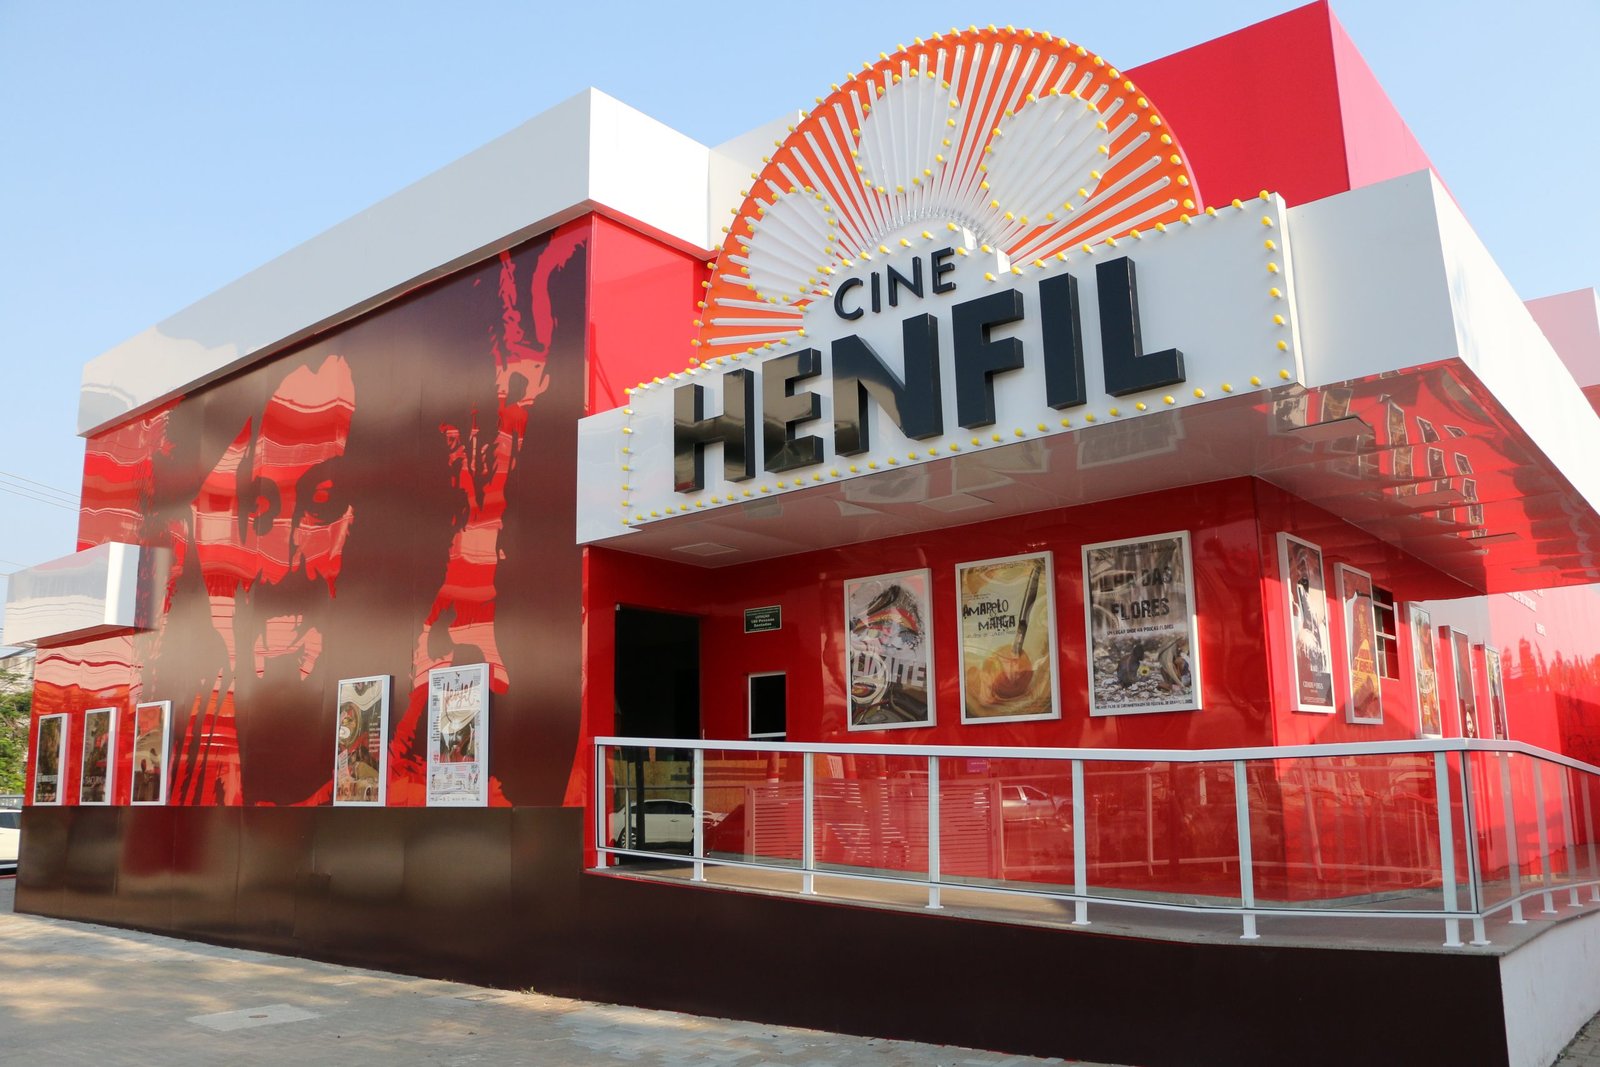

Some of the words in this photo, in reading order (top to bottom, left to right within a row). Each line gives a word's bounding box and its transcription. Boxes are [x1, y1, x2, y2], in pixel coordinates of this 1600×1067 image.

[834, 246, 957, 321] CINE
[673, 256, 1186, 493] HENFIL
[978, 615, 1016, 631] MANGA
[1110, 597, 1170, 621] FLORES
[852, 653, 926, 688] LIMITE
